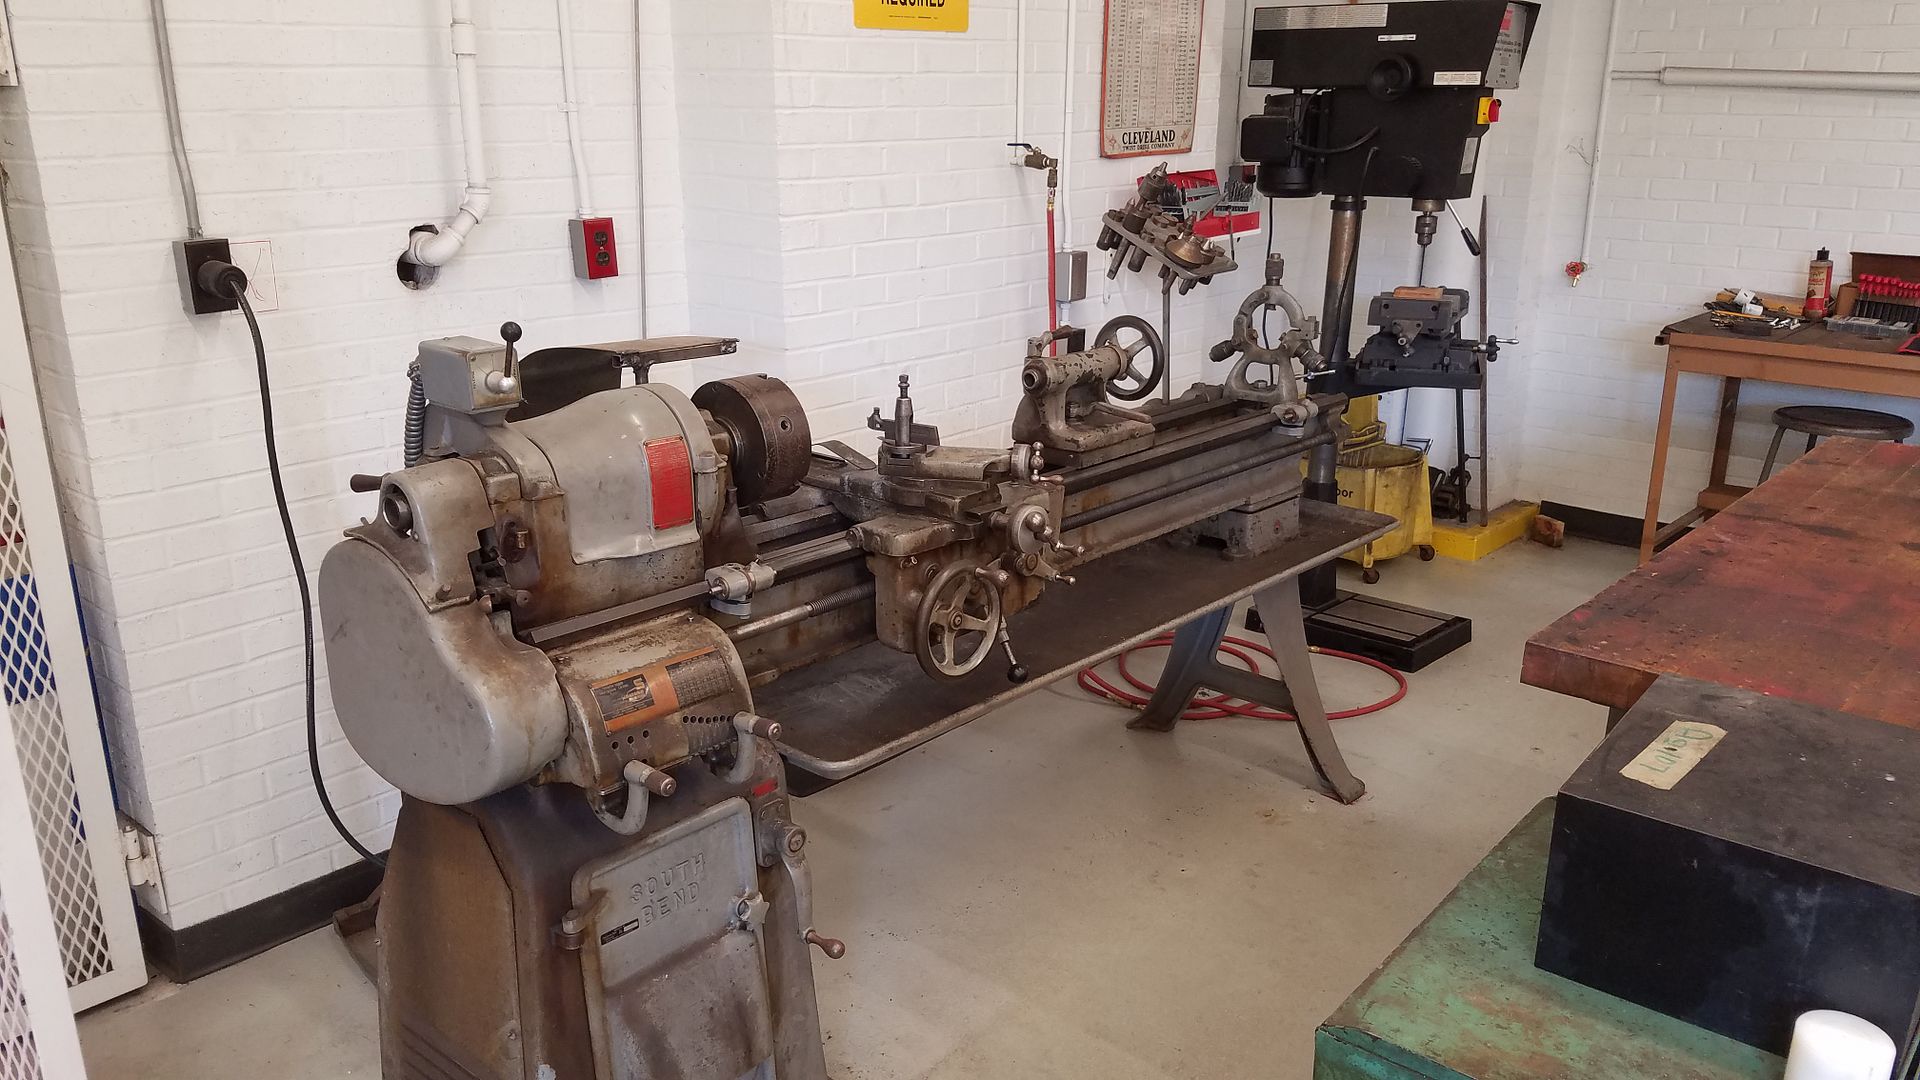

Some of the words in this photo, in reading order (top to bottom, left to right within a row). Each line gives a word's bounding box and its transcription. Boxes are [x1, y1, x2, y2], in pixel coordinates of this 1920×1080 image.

[1122, 130, 1176, 145] CLEVELAND
[631, 852, 705, 904] SOUTH
[641, 881, 700, 928] BEND
